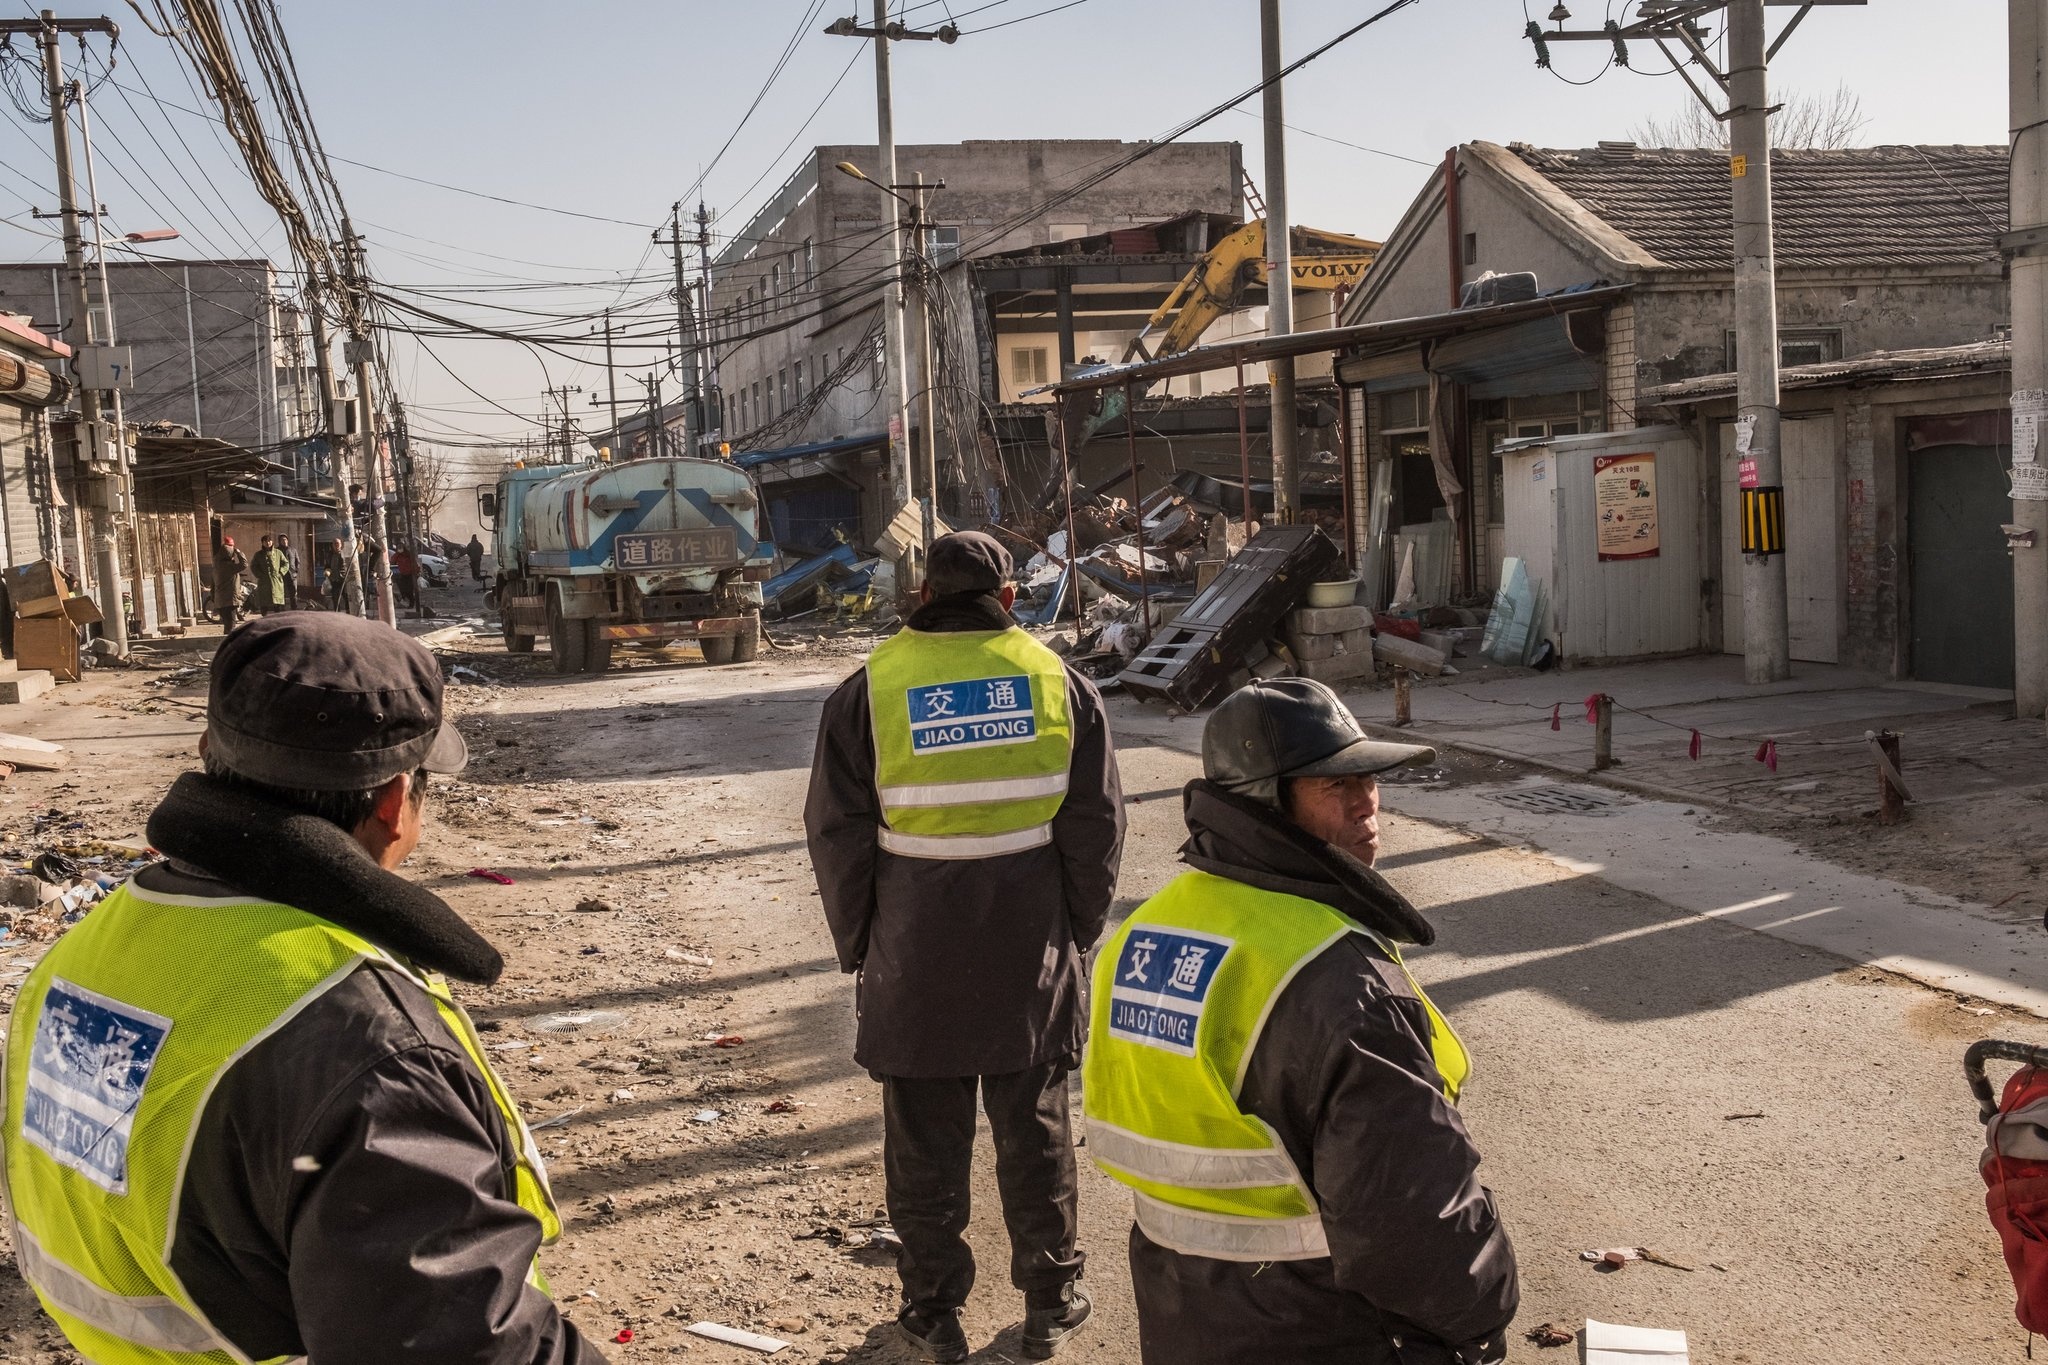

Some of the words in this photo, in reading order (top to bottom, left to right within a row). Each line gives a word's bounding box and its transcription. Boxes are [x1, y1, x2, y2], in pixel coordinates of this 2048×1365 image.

[110, 364, 121, 381] 7
[622, 536, 729, 564] 道路作业
[925, 680, 1018, 719] 交通
[920, 727, 965, 746] JIAO
[969, 719, 1028, 739] TONG
[1125, 938, 1210, 993] 交通
